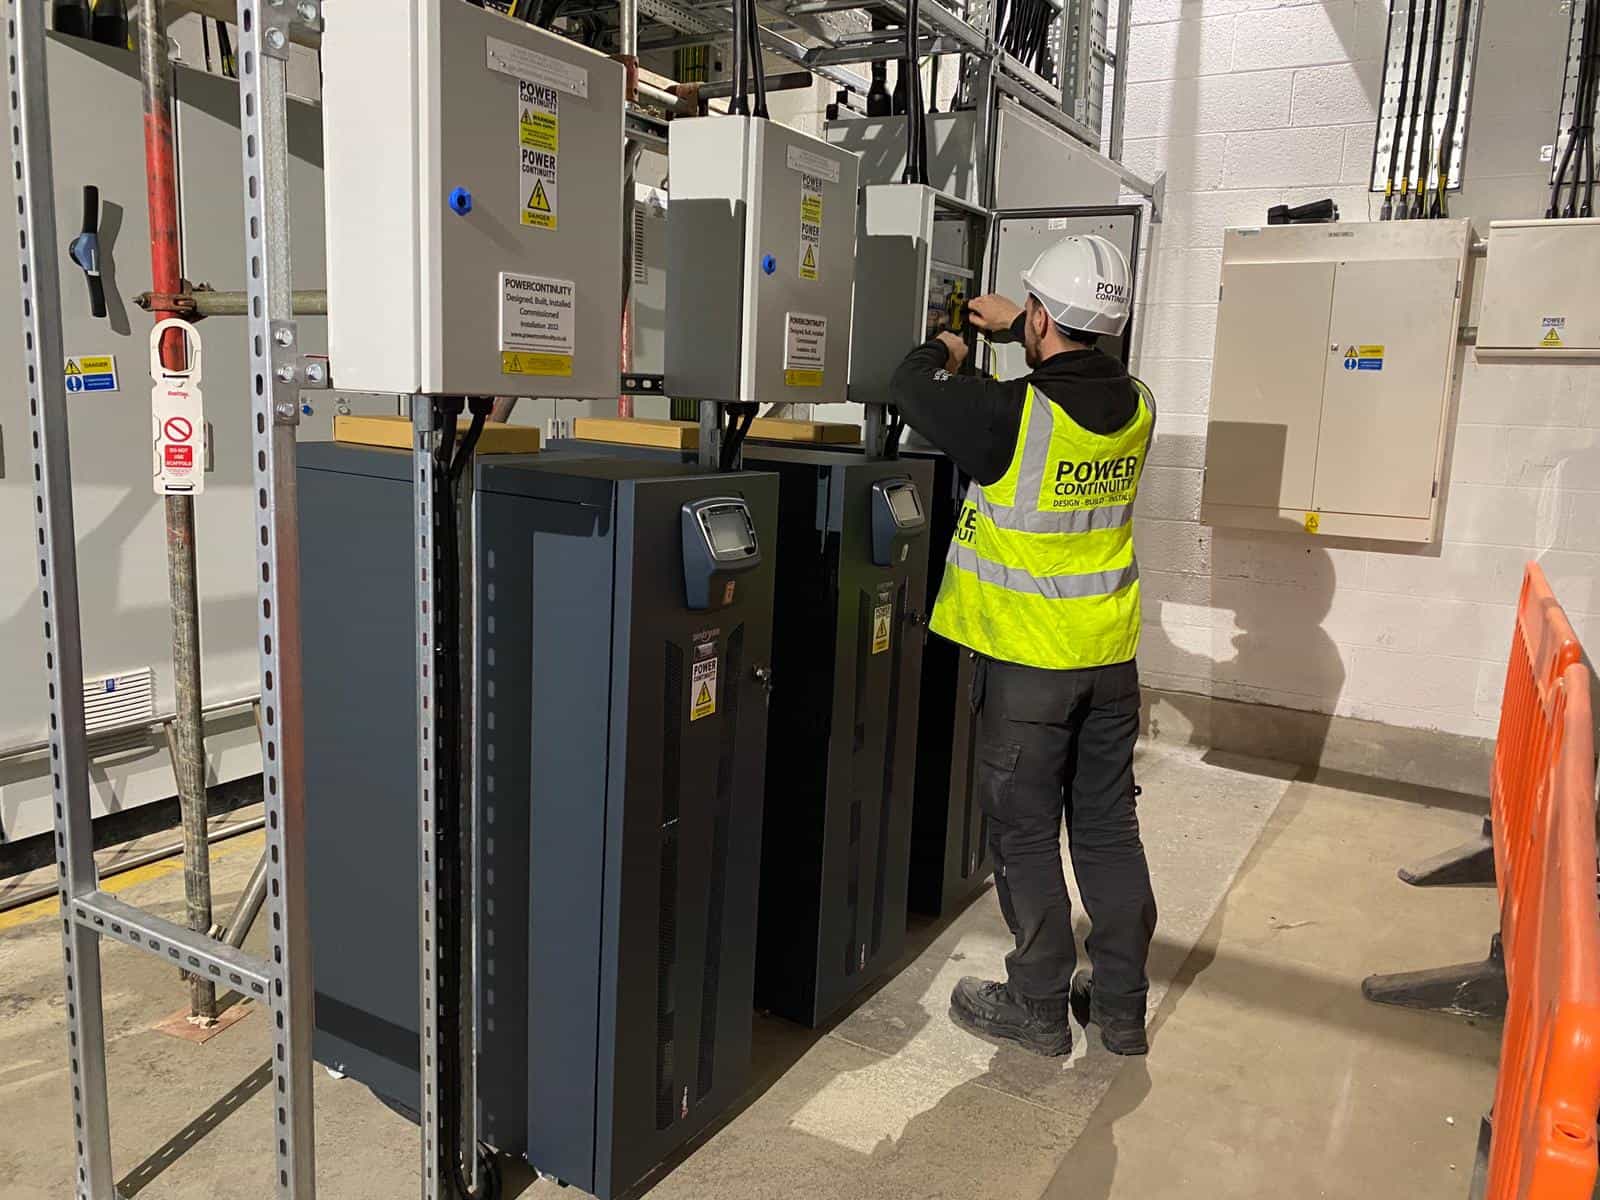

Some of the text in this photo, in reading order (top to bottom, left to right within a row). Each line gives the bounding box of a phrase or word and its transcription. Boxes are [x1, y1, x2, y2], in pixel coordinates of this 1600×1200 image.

[520, 80, 557, 103] POWER
[520, 94, 557, 110] CONTINUITY
[522, 149, 555, 170] POWER
[522, 164, 555, 179] CONTINUITY
[802, 174, 822, 188] POWER
[801, 222, 819, 236] POWER
[505, 279, 572, 296] POWERCONTINUITY
[1096, 282, 1124, 296] POW
[1056, 456, 1137, 482] POWER
[1055, 478, 1134, 495] CONTINUITY
[1053, 499, 1079, 508] DESIGN
[1085, 497, 1105, 505] BUILD
[694, 660, 717, 676] POWER
